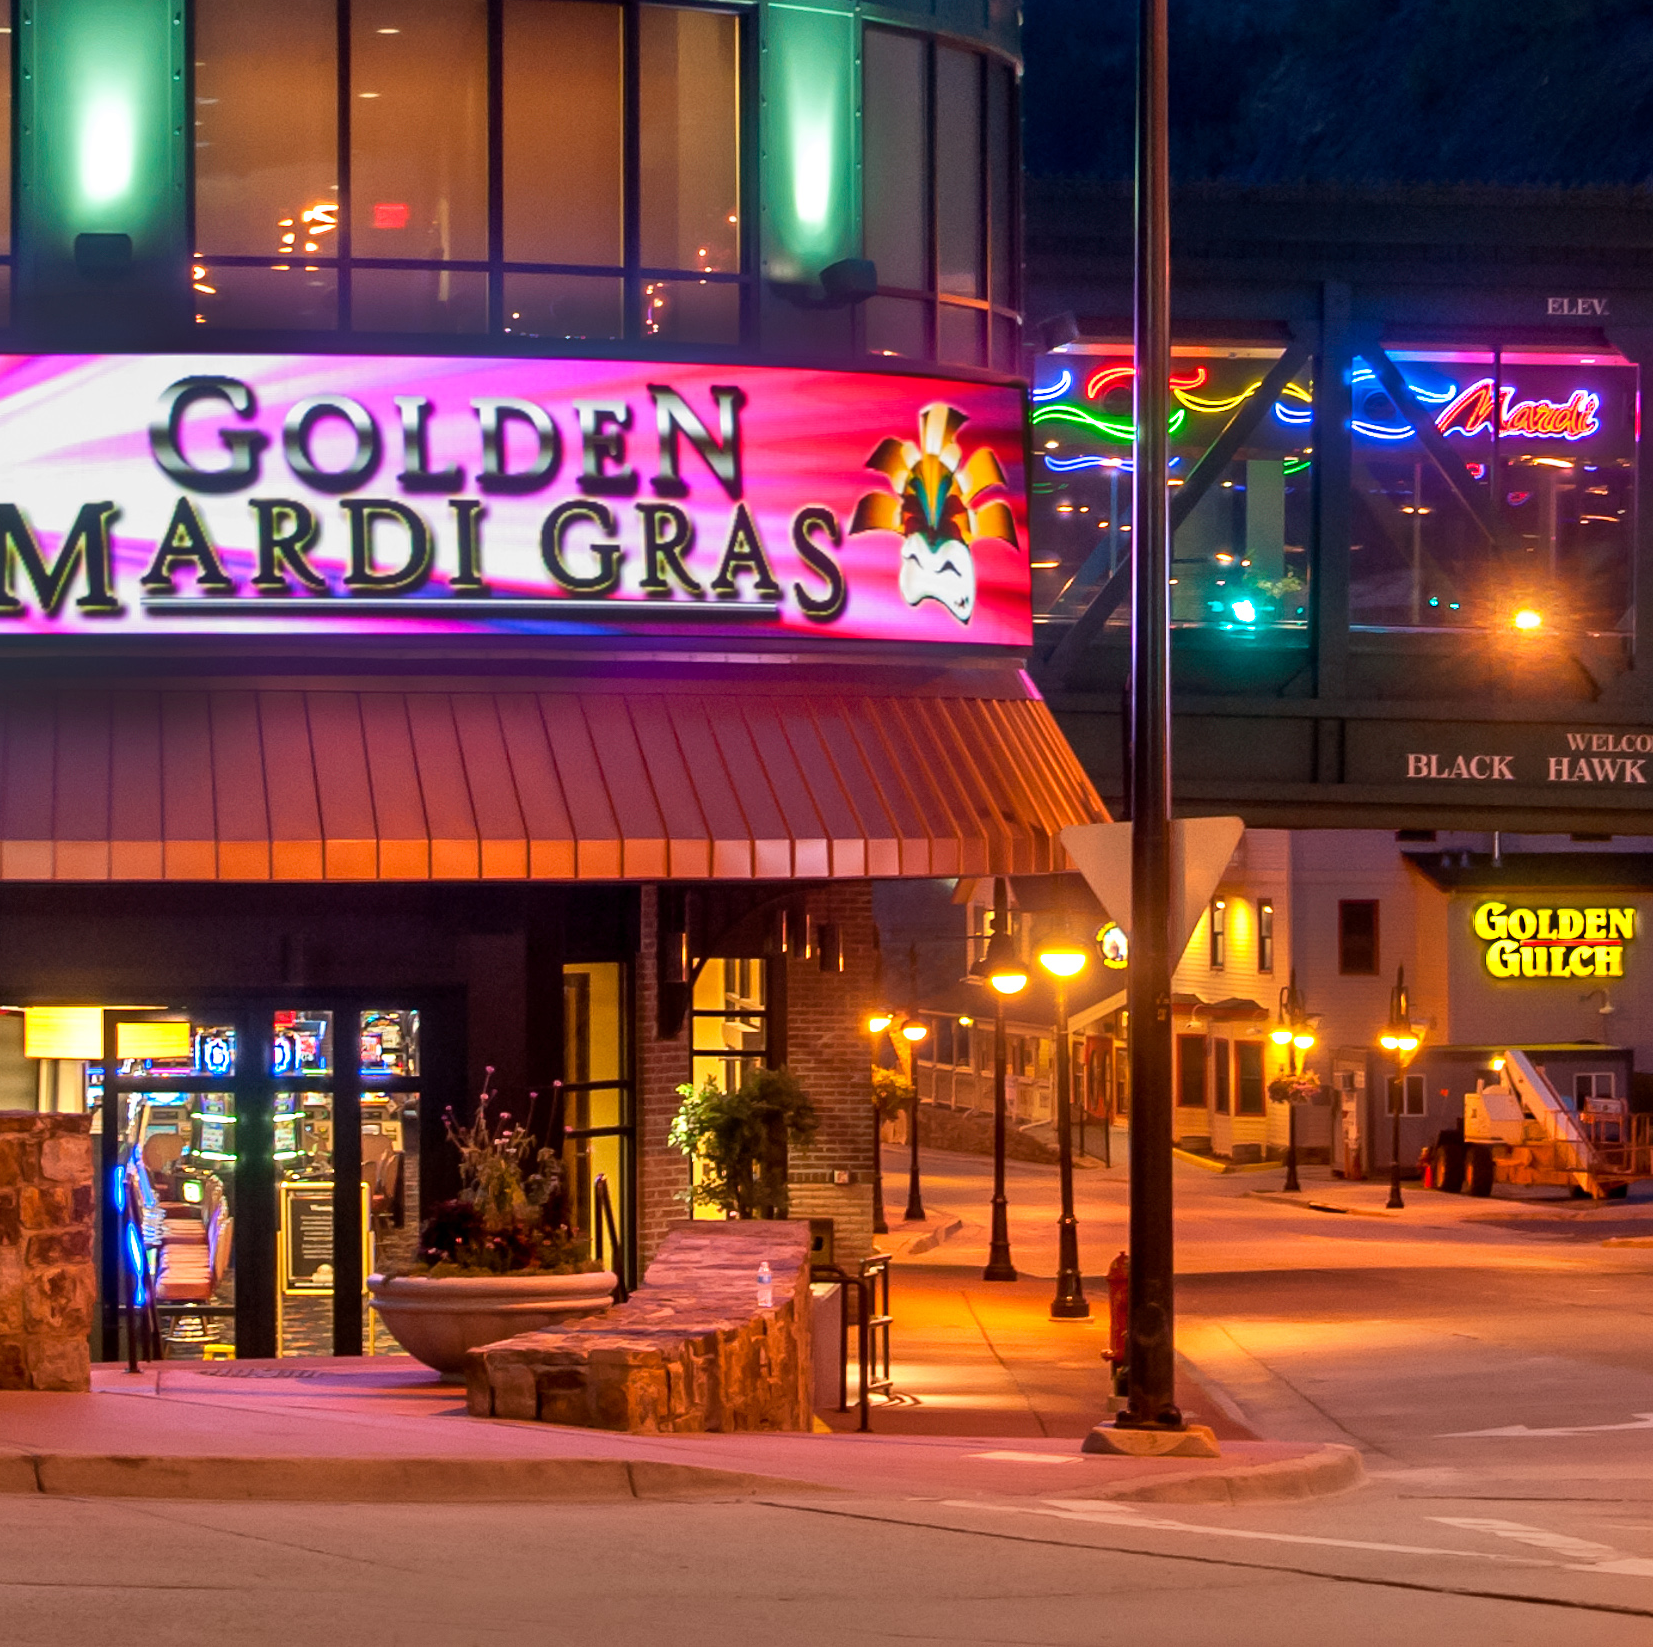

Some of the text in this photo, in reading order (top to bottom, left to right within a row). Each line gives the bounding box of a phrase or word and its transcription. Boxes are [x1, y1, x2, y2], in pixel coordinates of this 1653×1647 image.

[1547, 297, 1610, 316] ELEV.
[1434, 377, 1599, 441] Mardi
[151, 372, 748, 503] GOLDEN
[539, 499, 848, 621] GRAS
[1406, 754, 1516, 780] BLACK
[1547, 757, 1647, 783] HAWK
[1474, 901, 1636, 941] GOLDEN
[1485, 939, 1624, 978] GULCH
